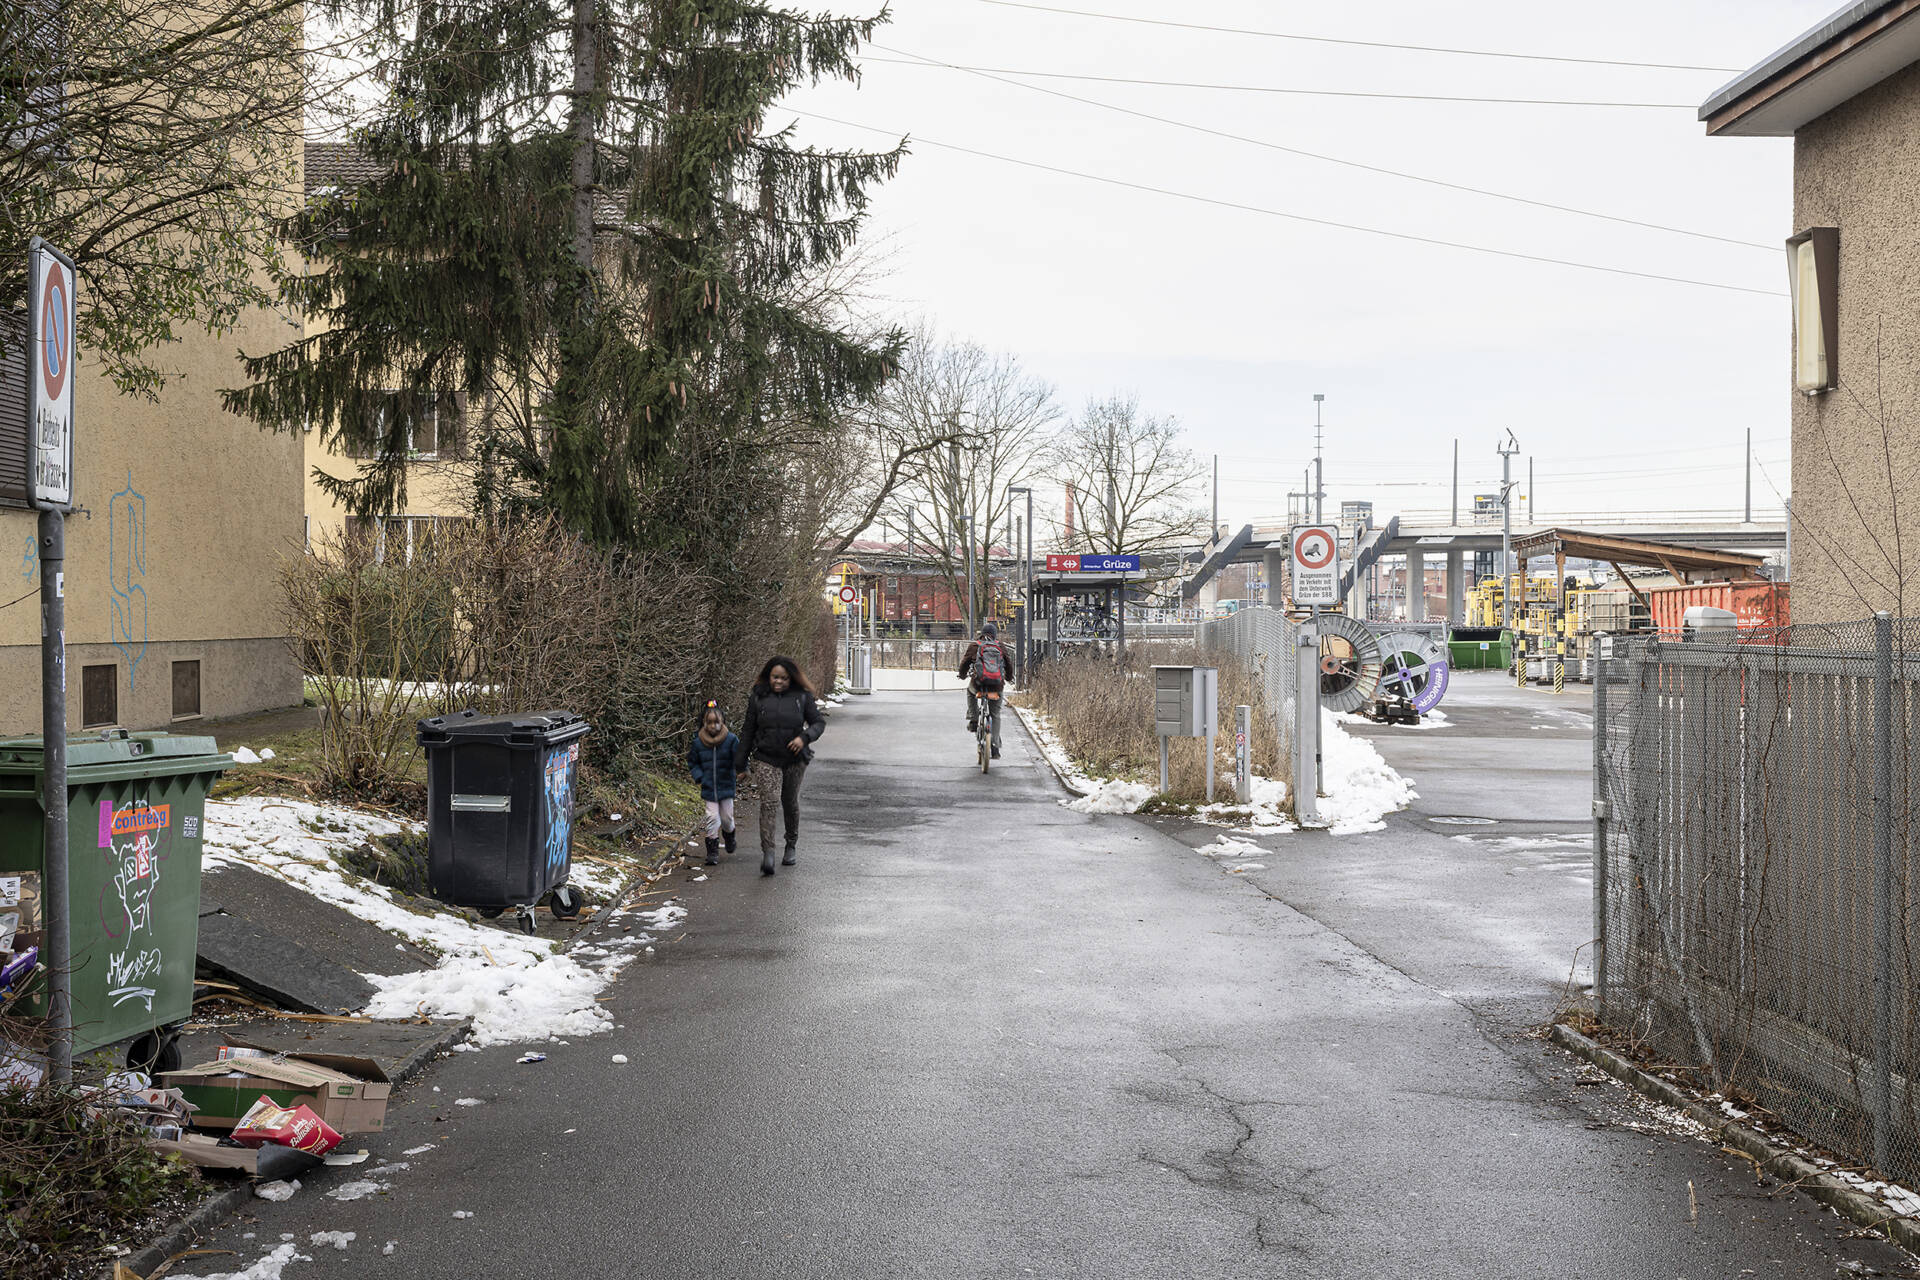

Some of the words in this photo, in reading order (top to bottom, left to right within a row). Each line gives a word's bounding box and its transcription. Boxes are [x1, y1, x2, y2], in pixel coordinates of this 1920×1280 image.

[1102, 559, 1132, 569] Grüze
[1418, 667, 1443, 708] HEINIGER
[115, 810, 167, 829] contreag
